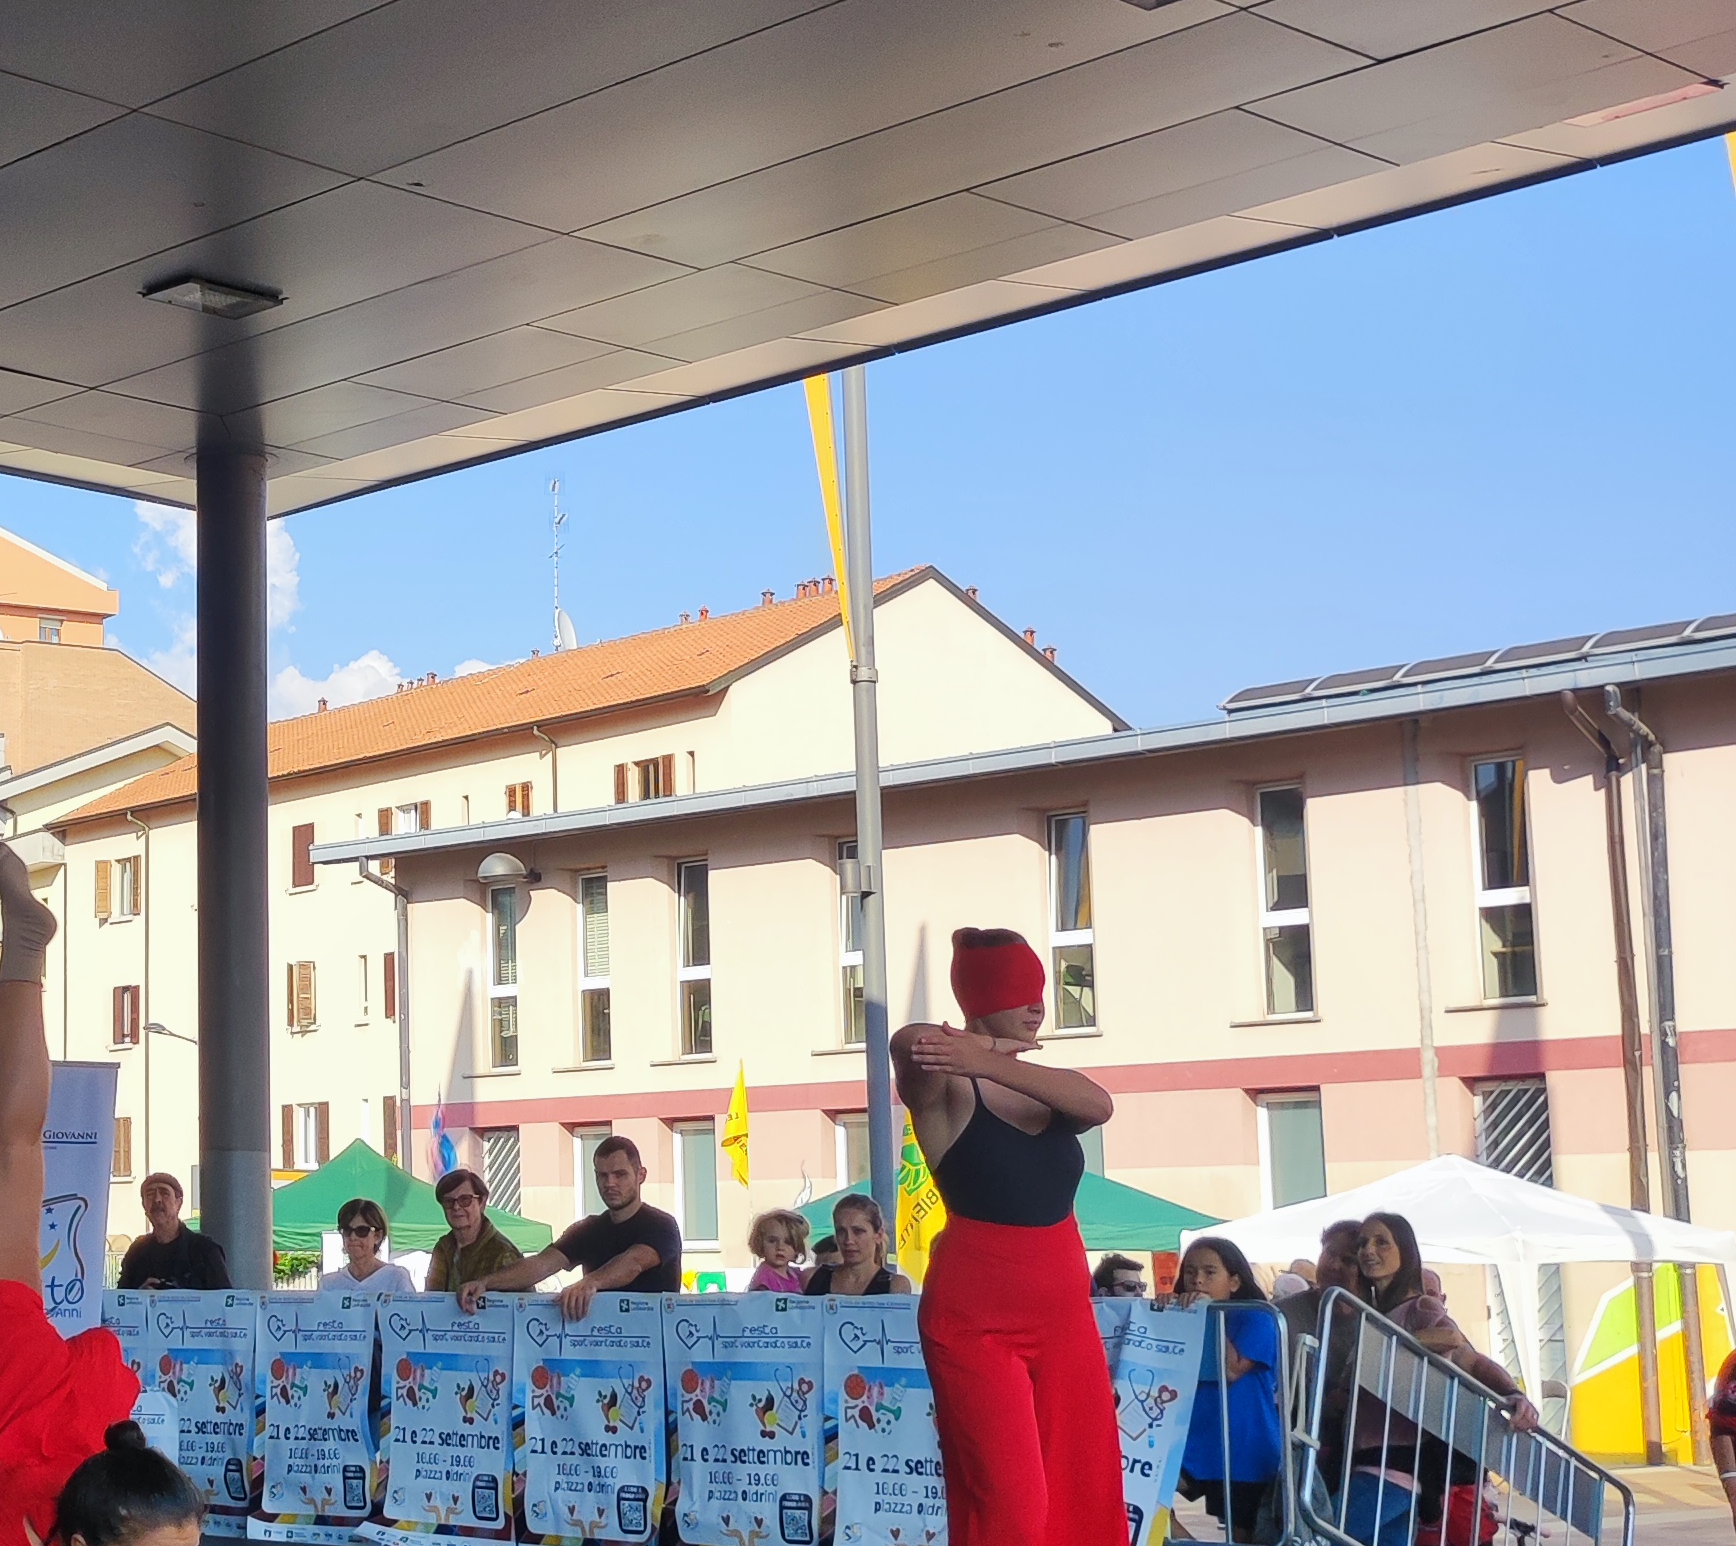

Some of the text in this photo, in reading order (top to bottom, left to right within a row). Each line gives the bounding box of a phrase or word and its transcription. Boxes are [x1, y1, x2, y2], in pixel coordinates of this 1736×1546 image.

[42, 1129, 98, 1140] GIOVANNI
[741, 1324, 778, 1335] festa
[179, 1418, 244, 1436] 22 settembre
[268, 1423, 360, 1443] 21 e 22 settembre
[393, 1426, 501, 1451] 21 e 22 settembre
[528, 1436, 647, 1460] 21 e 22 settembre
[681, 1443, 811, 1467] 21 e 22 settembre
[842, 1451, 862, 1471] 21
[866, 1456, 876, 1473] e
[880, 1453, 900, 1474] 22
[874, 1481, 907, 1497] 10.00
[873, 1500, 913, 1515] piazza
